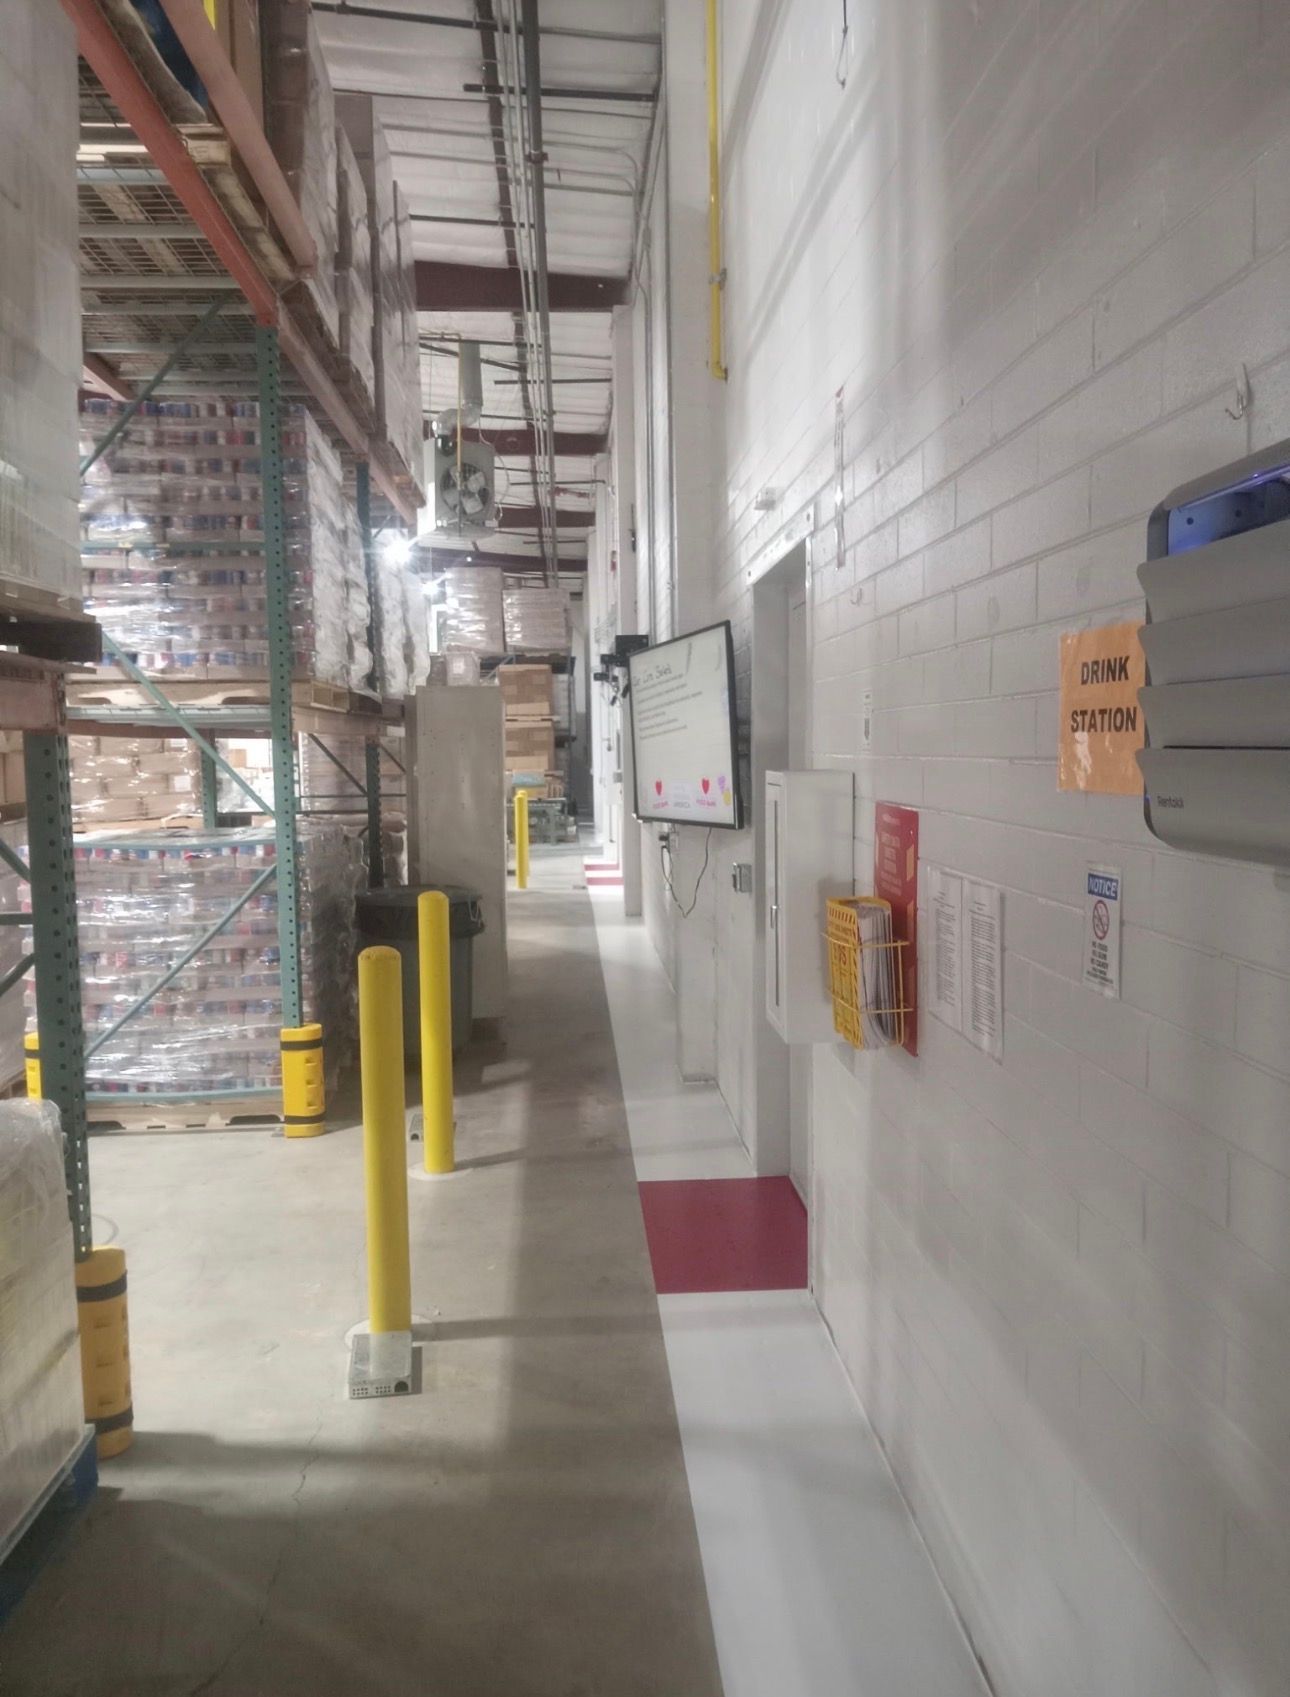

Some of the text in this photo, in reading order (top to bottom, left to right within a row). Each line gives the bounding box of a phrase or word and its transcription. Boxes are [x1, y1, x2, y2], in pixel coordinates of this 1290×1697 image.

[1081, 655, 1130, 685] DRINK
[1071, 706, 1137, 733] STATION
[1088, 876, 1117, 897] NOTICE
